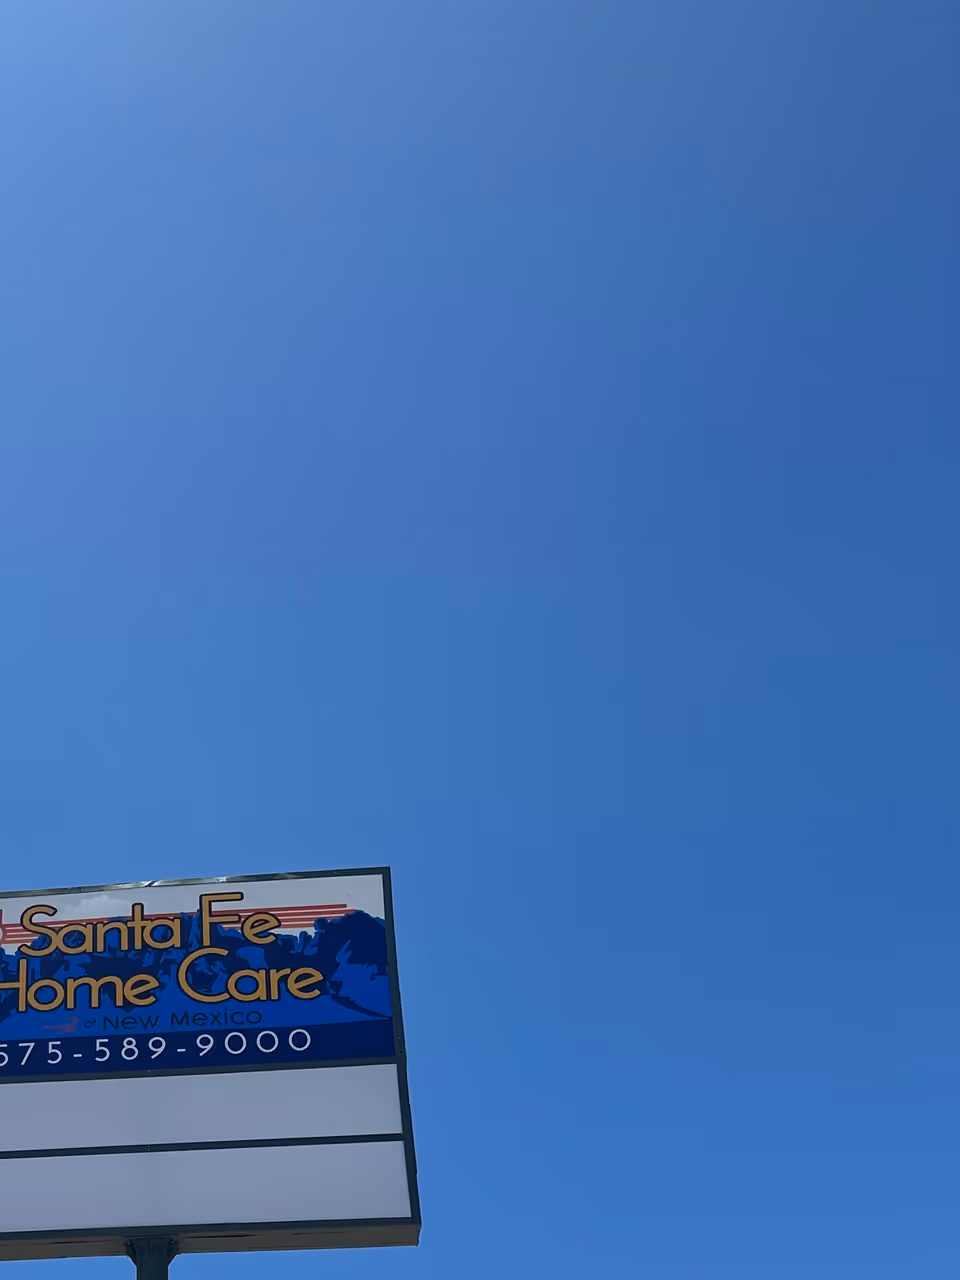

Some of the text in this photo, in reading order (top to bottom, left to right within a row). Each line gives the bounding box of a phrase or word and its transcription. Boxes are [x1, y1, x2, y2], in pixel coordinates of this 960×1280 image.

[20, 891, 281, 957] Santa Fe
[177, 947, 324, 1003] Care
[103, 1015, 160, 1031] New
[171, 1010, 262, 1027] Mexico
